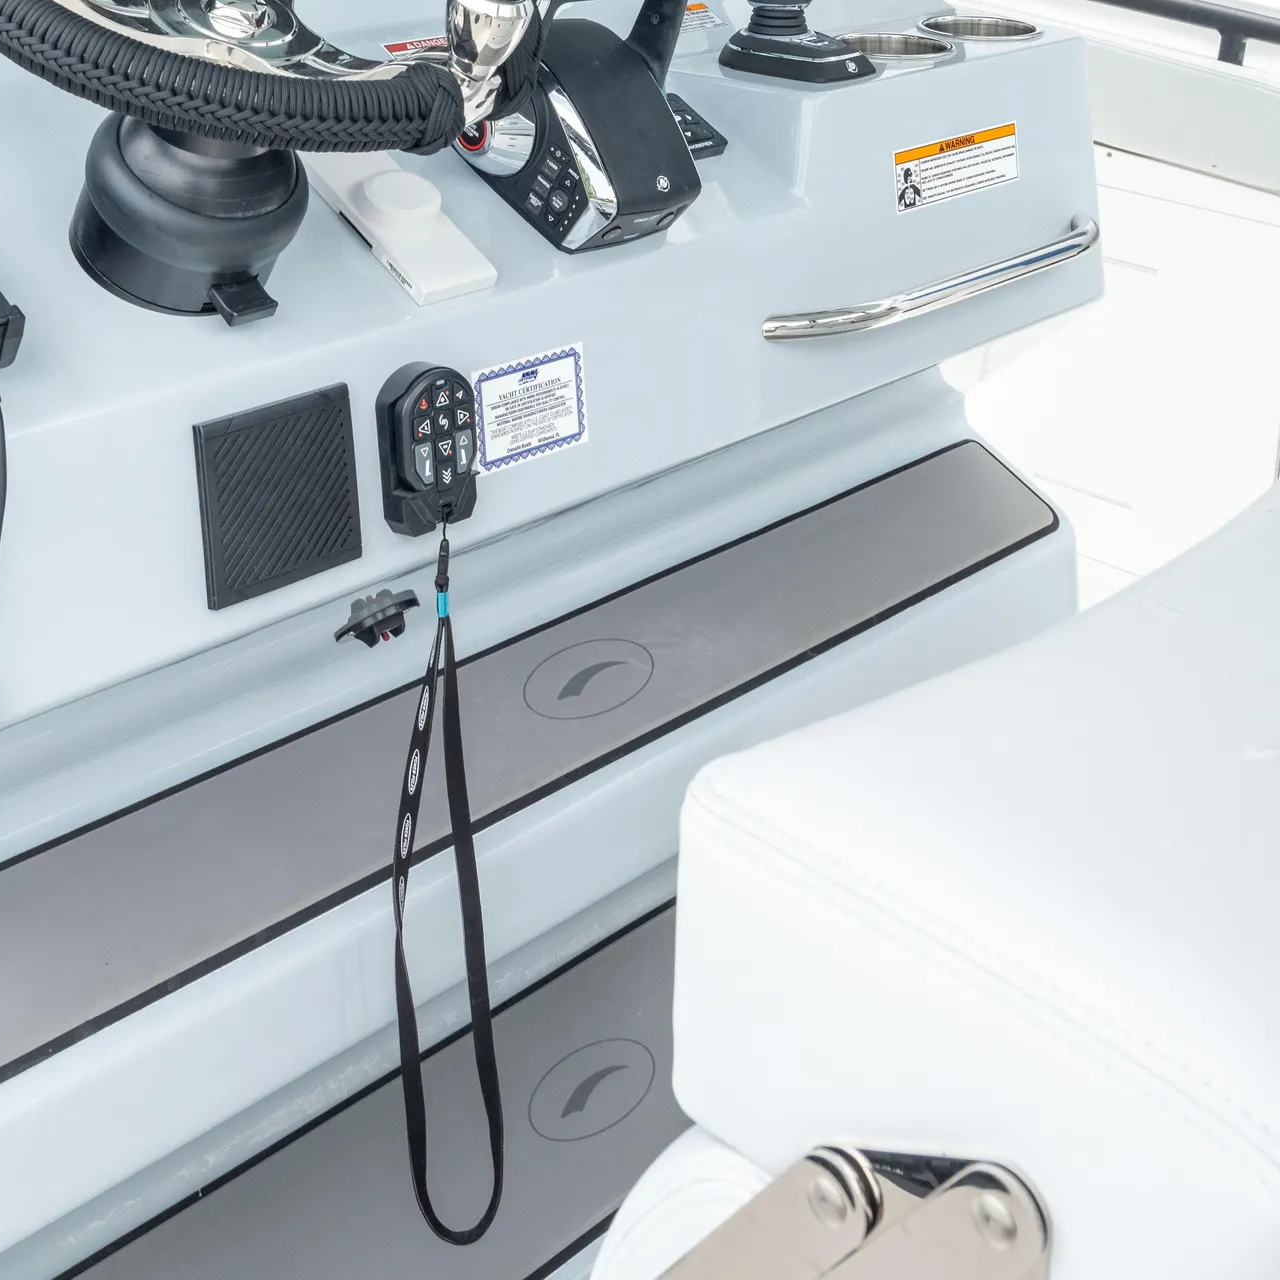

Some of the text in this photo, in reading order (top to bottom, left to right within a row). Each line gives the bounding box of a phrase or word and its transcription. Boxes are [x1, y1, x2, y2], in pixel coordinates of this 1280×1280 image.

[412, 37, 447, 48] DANGE
[945, 135, 975, 150] WARNING
[499, 390, 517, 401] YACHT
[518, 377, 561, 395] CERTIFICATION
